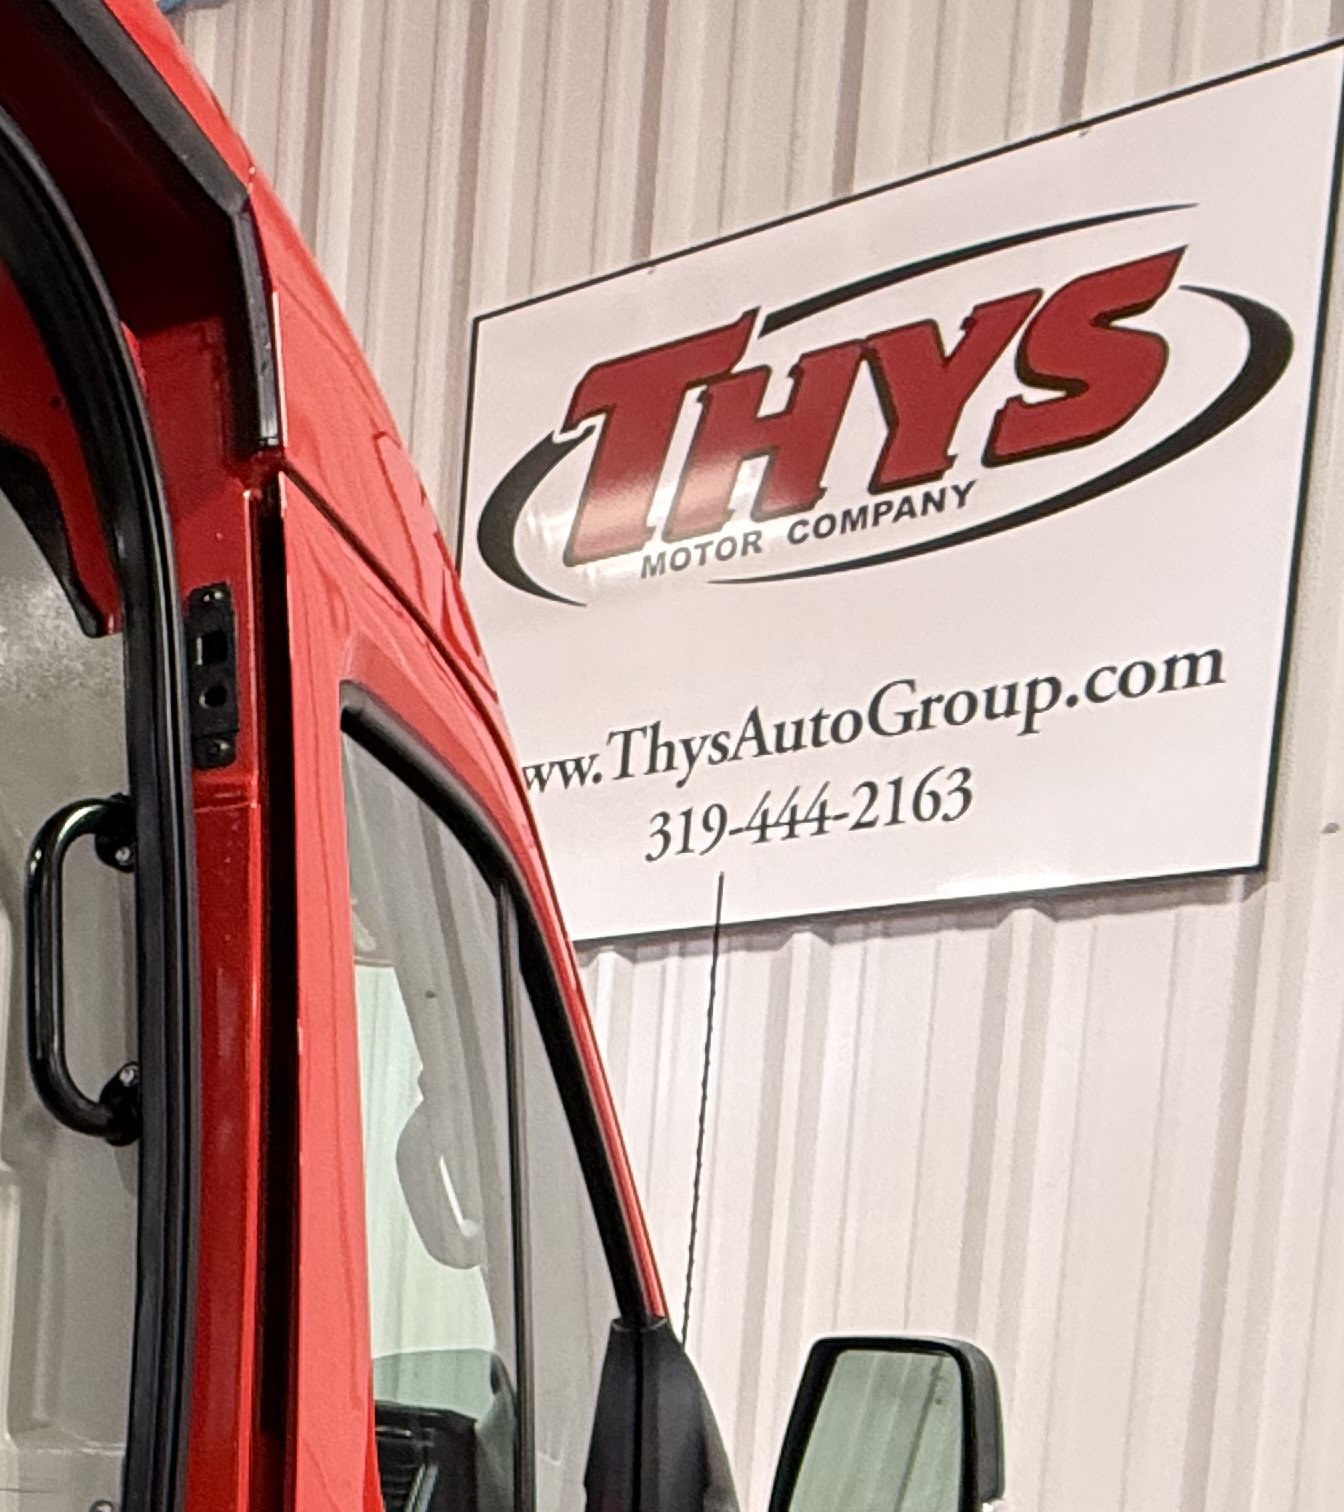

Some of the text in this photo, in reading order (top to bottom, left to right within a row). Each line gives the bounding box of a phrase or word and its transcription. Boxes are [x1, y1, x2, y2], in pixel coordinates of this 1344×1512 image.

[563, 245, 1188, 567] THYS
[640, 480, 977, 579] MOTOR COMPANY
[521, 648, 1226, 793] ww.ThysAutoGroup.com
[645, 766, 974, 863] 319-444-2163
